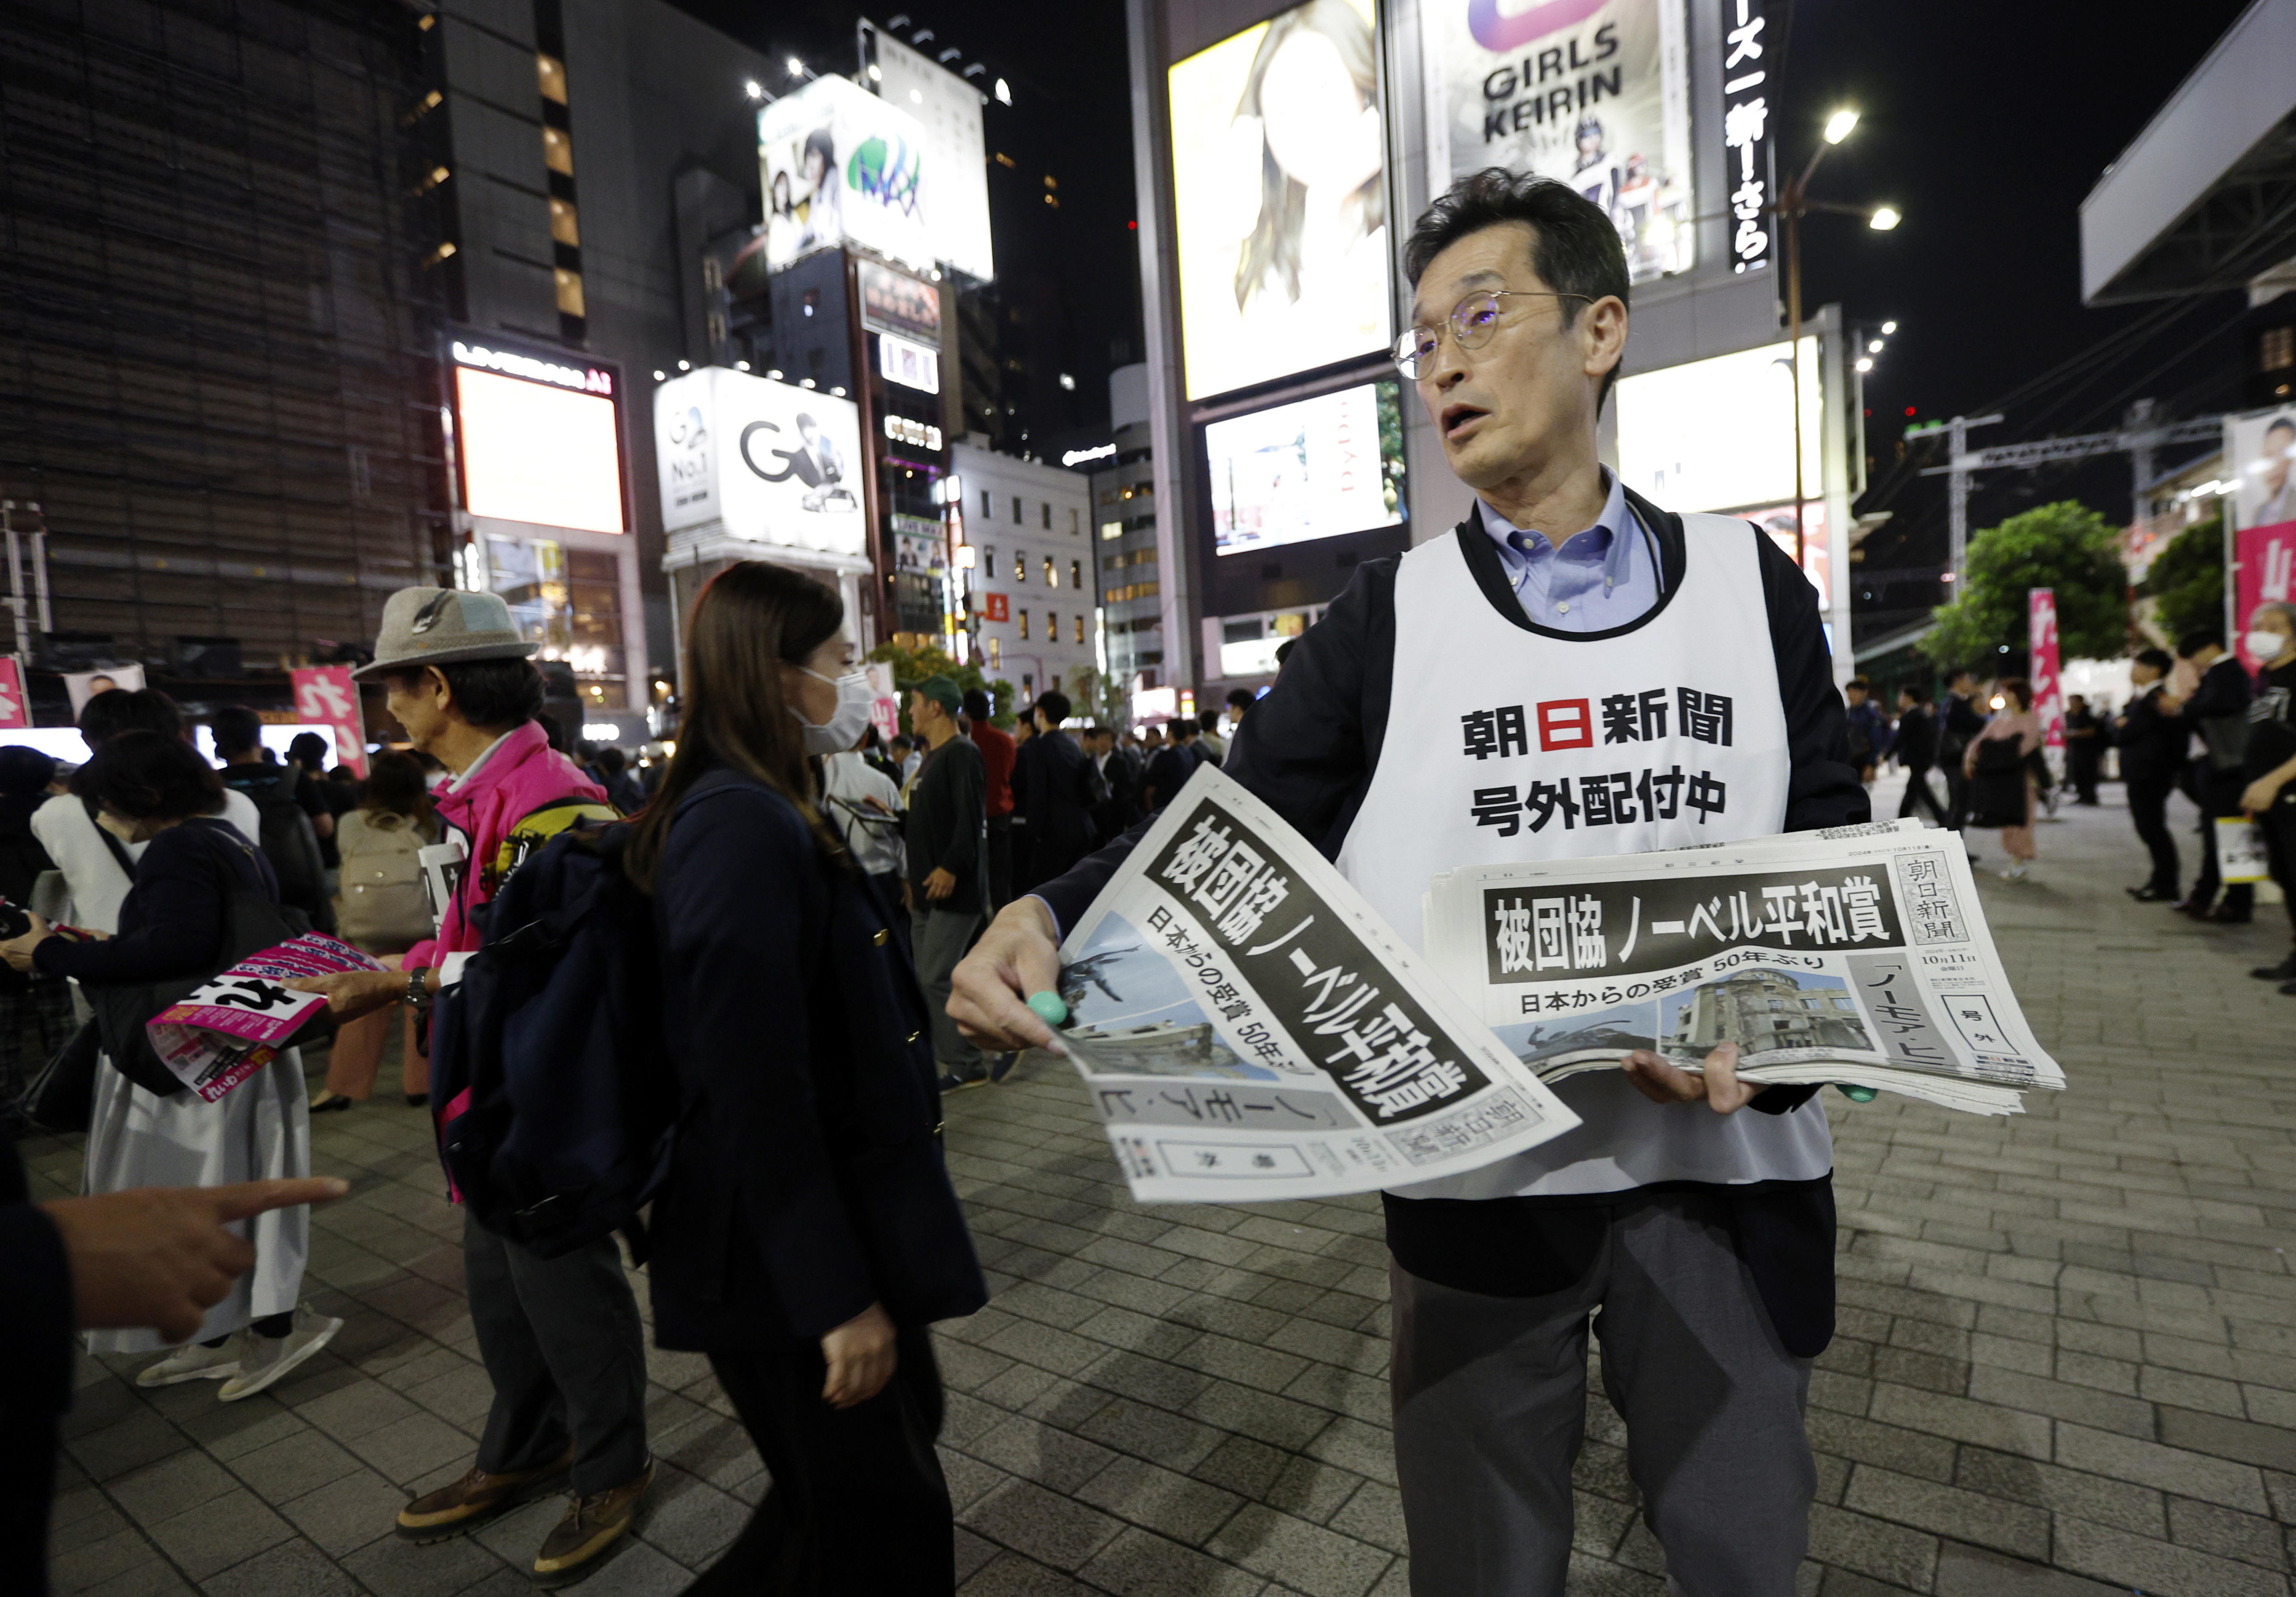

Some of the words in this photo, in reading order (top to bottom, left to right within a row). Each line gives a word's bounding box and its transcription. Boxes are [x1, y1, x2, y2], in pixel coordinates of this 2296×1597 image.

[1484, 23, 1619, 101] GIRLS
[1485, 66, 1621, 143] KEIRIN
[1461, 687, 1733, 760] 朝日新聞
[1471, 765, 1726, 837] 号外配付中
[1495, 893, 1607, 974] 被団協
[1618, 875, 1891, 963] ノーベル平和賞
[1908, 860, 1955, 939] 朝日新聞
[1147, 905, 1252, 1022] 日本からの受賞
[1161, 814, 1289, 946] 被団協
[1245, 914, 1467, 1118] ノーベル平和賞
[1521, 967, 1704, 1015] 日本からの受賞
[1714, 951, 1824, 972] 50年ぶり
[1921, 954, 1976, 965] 10月11日
[1960, 1010, 1997, 1043] 号外
